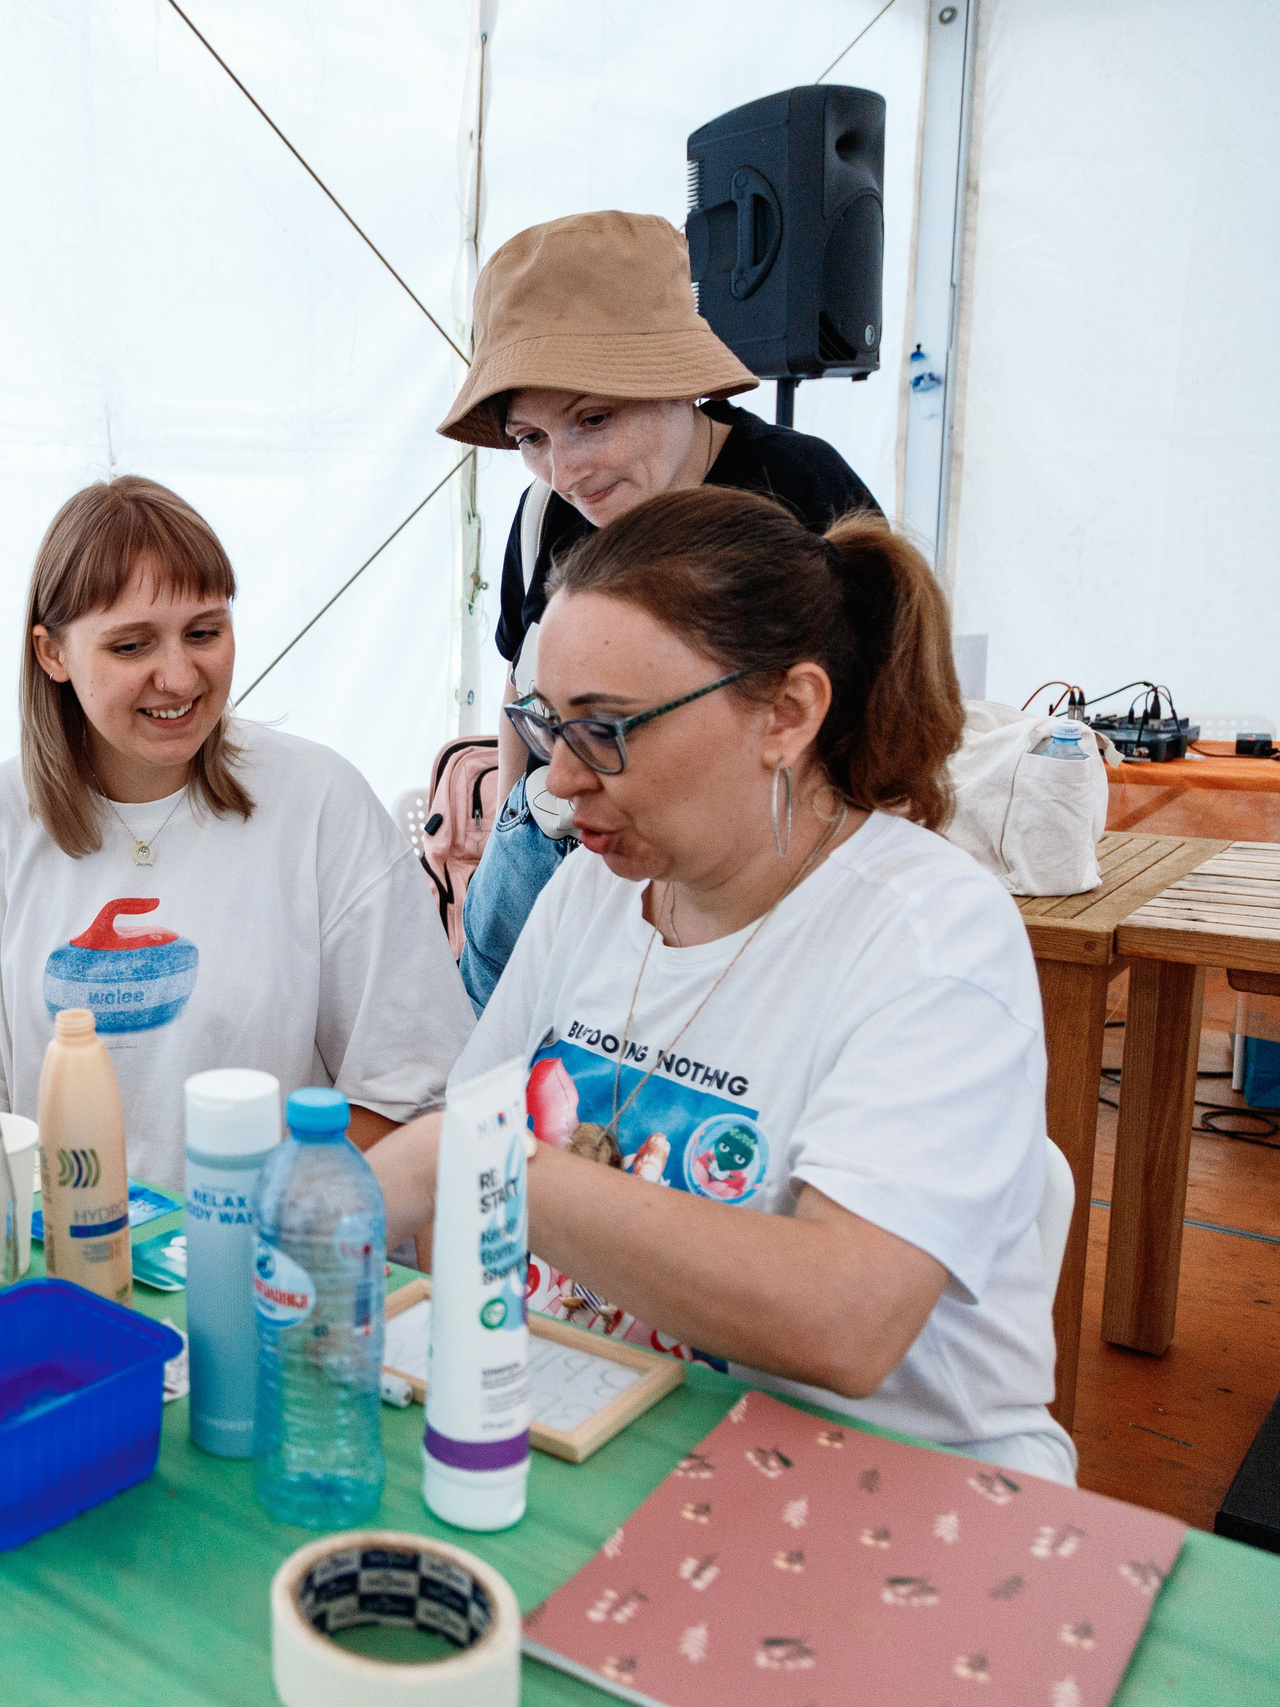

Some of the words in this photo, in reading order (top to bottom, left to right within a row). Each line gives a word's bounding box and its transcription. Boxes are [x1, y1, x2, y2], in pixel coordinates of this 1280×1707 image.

[656, 1049, 749, 1096] NOTHNG
[193, 1189, 247, 1208] RELAX
[480, 1178, 519, 1214] START
